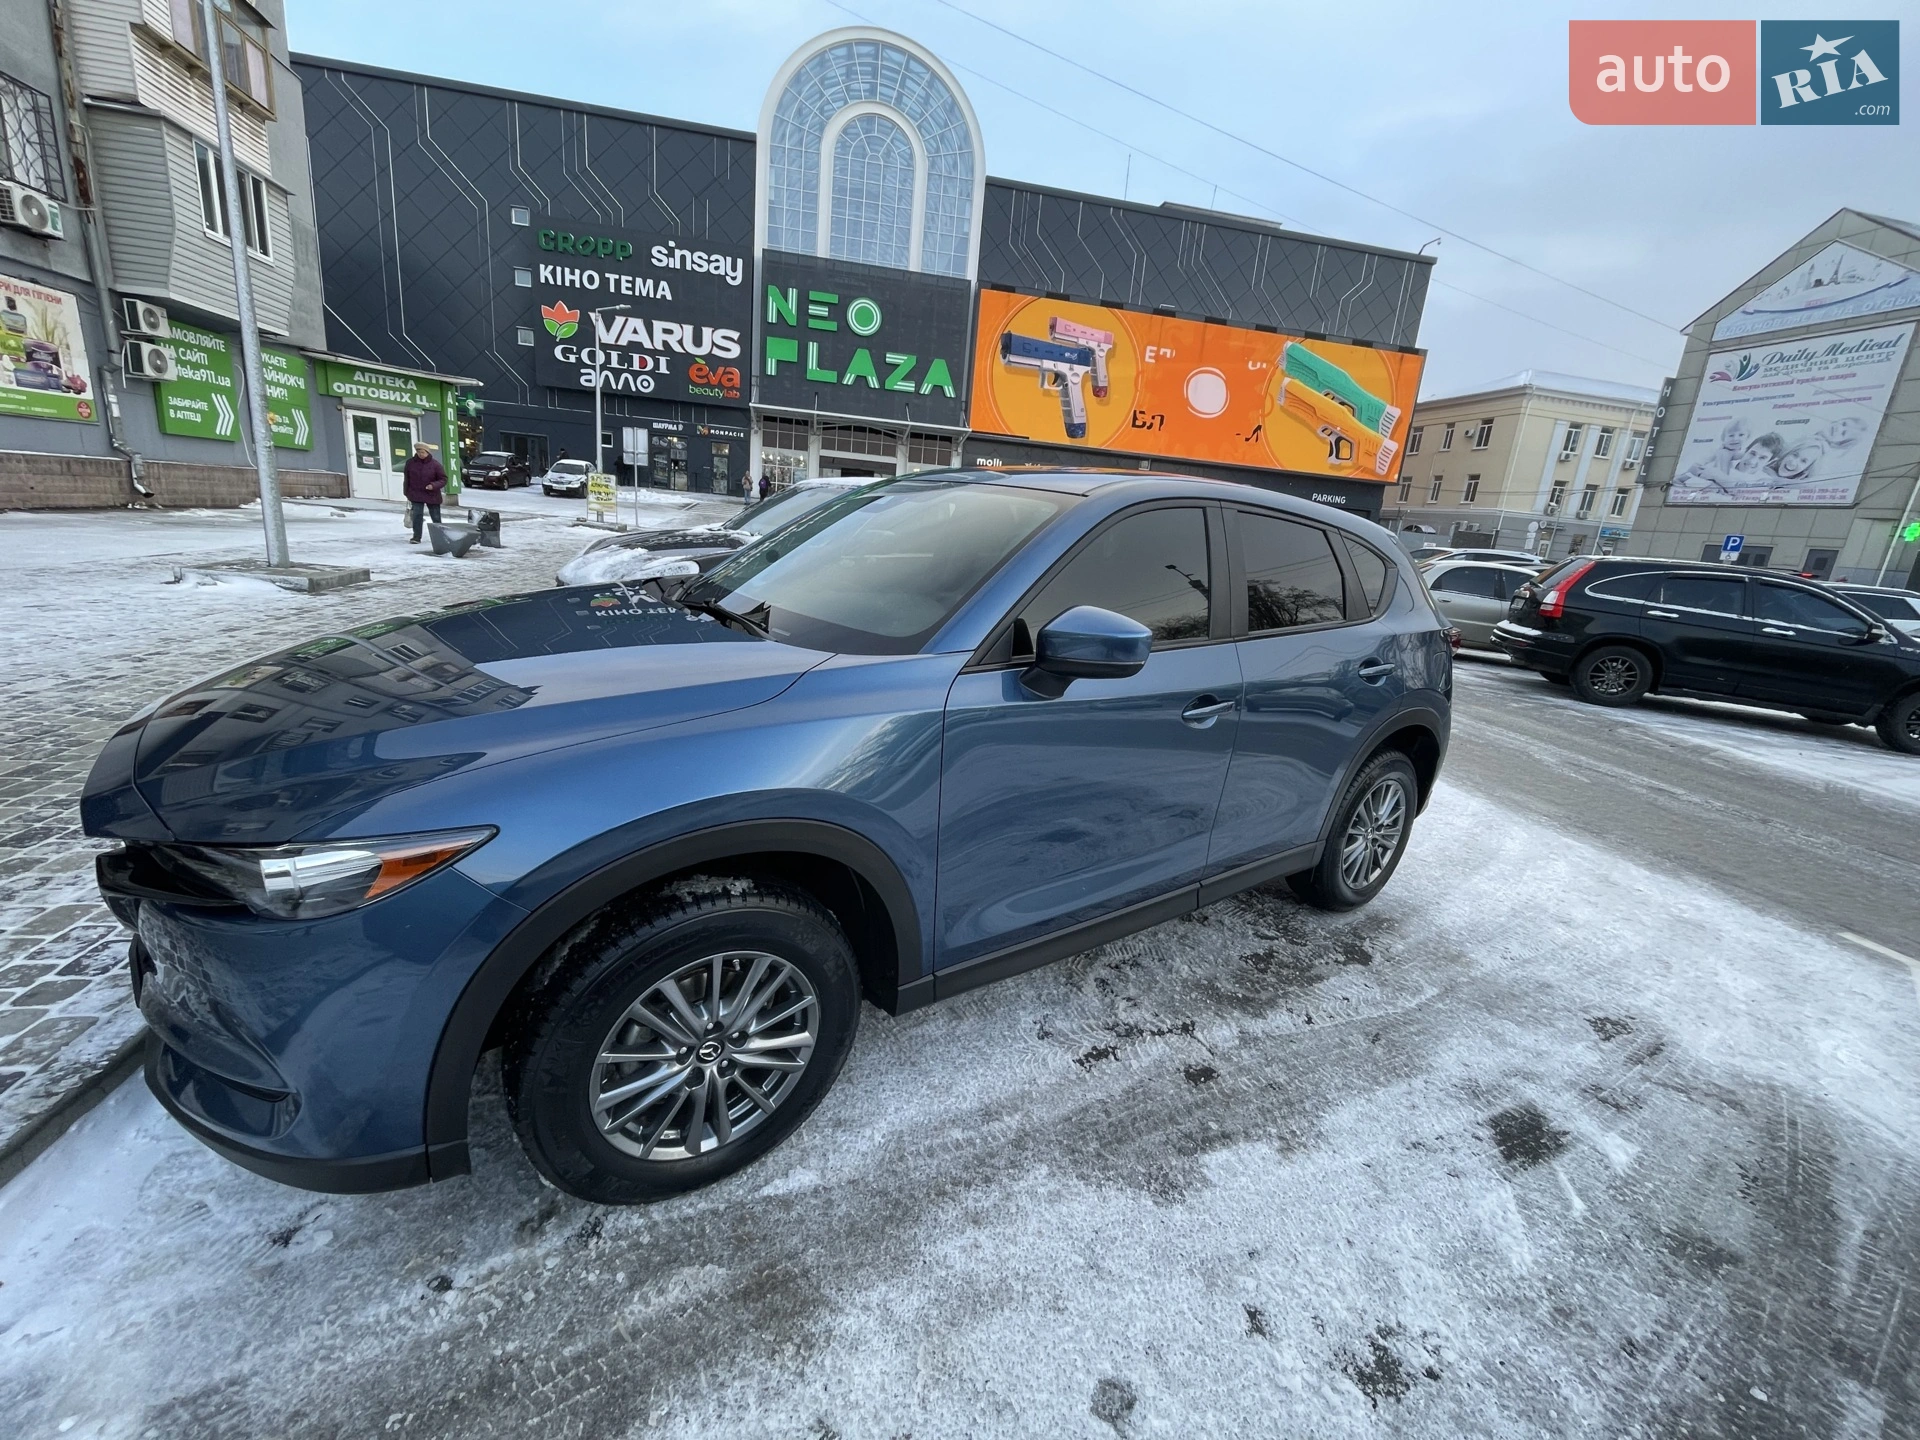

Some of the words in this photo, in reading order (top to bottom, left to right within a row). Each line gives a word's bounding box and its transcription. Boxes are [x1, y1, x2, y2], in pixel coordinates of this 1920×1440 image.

[538, 229, 633, 262] CROPP
[650, 240, 743, 286] sinsay
[539, 263, 600, 290] КІНО
[605, 272, 673, 301] ТЕМА
[766, 284, 883, 337] NEO
[169, 326, 226, 352] МОВЛЯЙТЕ
[588, 311, 742, 359] VARUS
[1761, 347, 1818, 366] Daily
[1815, 332, 1906, 358] Medical
[178, 346, 208, 365] САЙТІ
[553, 344, 671, 375] GOLDI
[765, 336, 956, 398] PLAZA
[332, 381, 412, 404] ОПТОВИХ
[353, 370, 418, 391] АПТЕКА
[168, 395, 209, 411] ЗАБИРАЙТЕ
[446, 390, 459, 488] АПТЕКА
[1639, 384, 1672, 477] HOTEL
[1312, 492, 1346, 505] PARKING
[1727, 537, 1739, 550] P
